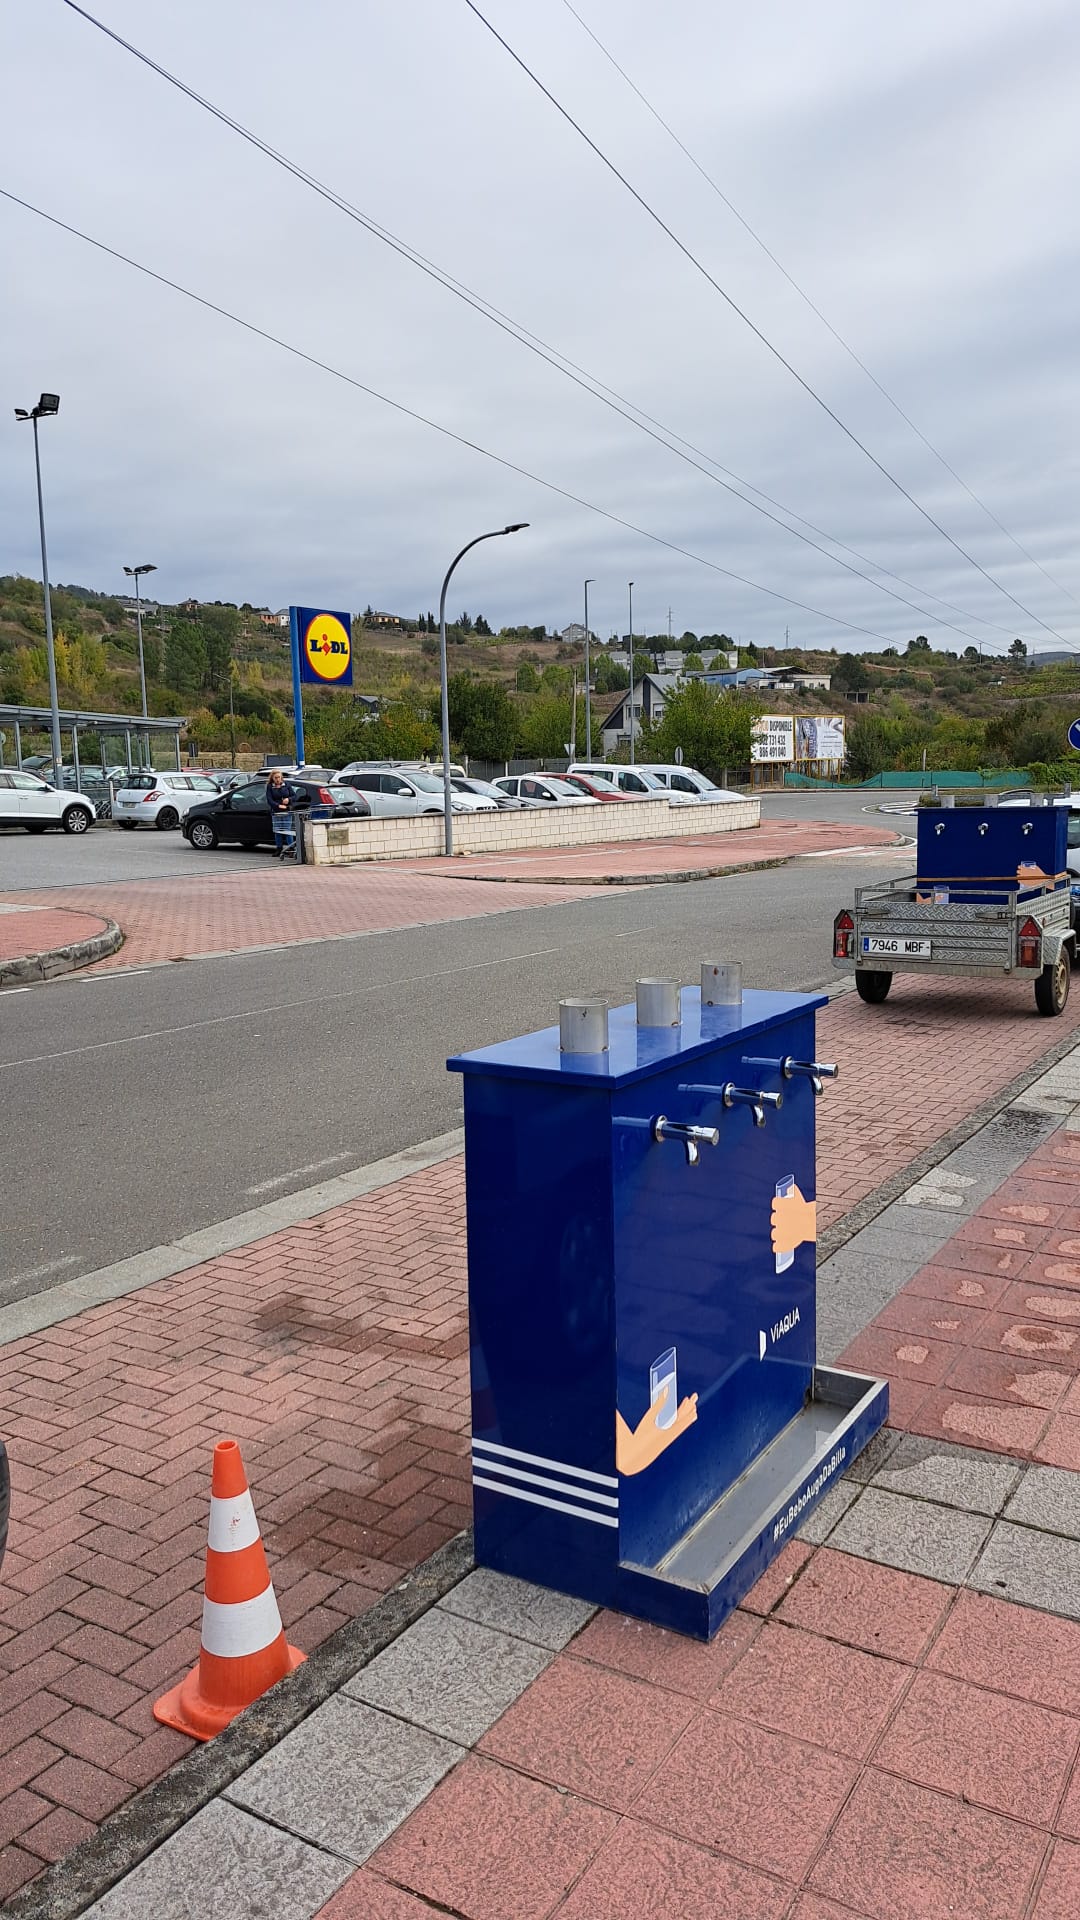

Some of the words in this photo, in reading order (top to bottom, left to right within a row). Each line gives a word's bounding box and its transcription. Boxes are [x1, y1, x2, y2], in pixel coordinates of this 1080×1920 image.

[769, 720, 792, 731] DISPONIBLE
[872, 939, 898, 951] 7946
[904, 942, 925, 953] MBF
[773, 1446, 846, 1542] #EuBeboAugaDaBilla
